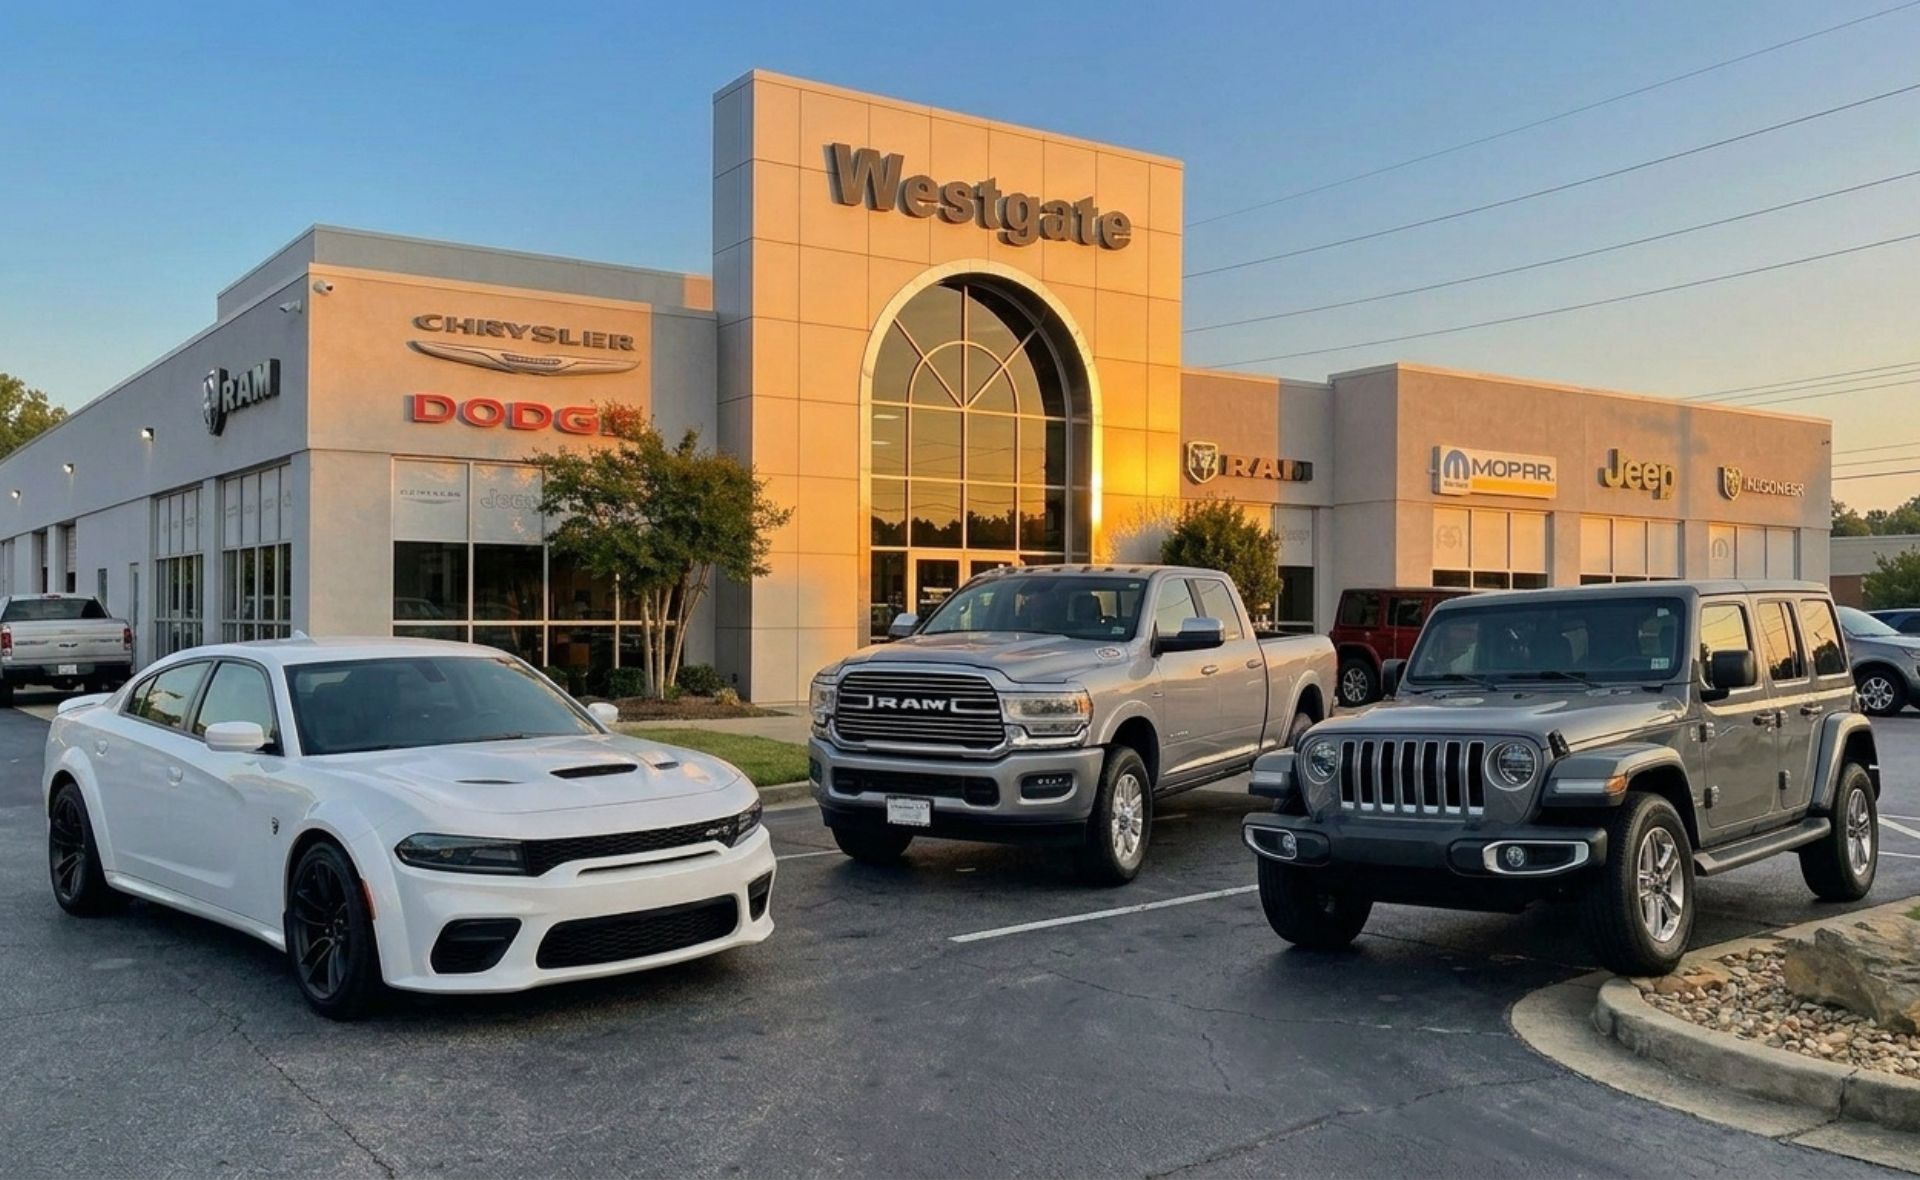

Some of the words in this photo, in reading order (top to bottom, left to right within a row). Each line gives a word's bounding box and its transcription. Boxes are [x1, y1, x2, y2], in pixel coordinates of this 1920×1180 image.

[824, 142, 1132, 250] Westgate
[413, 314, 636, 351] CHRYSLER
[221, 359, 278, 413] RAM
[411, 393, 620, 436] DODG
[1472, 458, 1551, 481] MOPAR
[1600, 449, 1677, 500] Jeep
[876, 696, 947, 711] RAM
